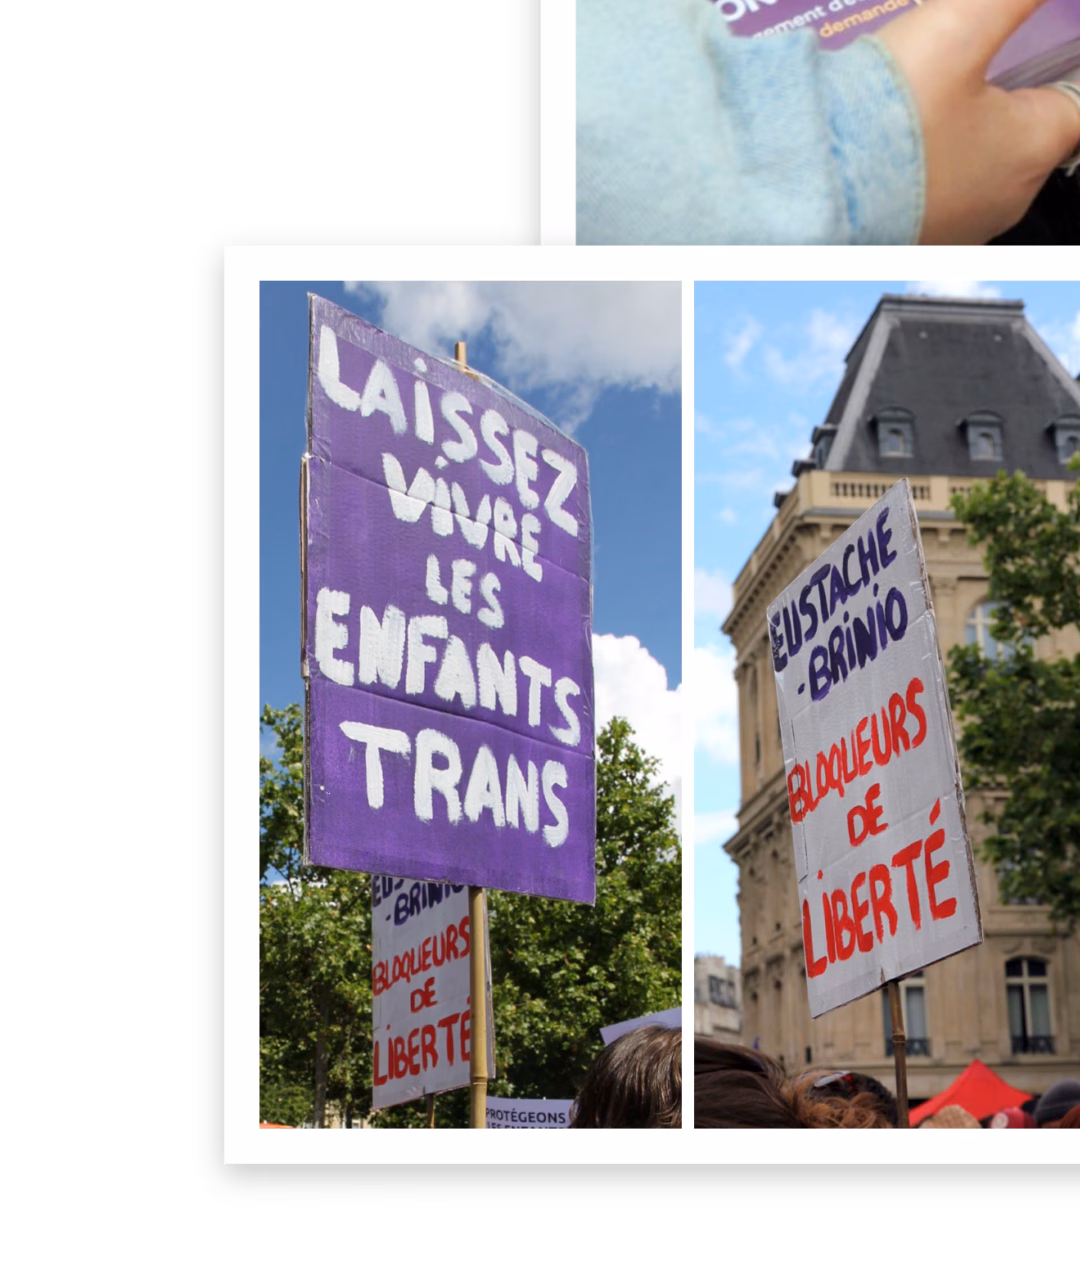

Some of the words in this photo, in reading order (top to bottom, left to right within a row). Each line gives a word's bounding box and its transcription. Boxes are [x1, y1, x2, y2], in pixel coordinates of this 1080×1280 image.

[426, 554, 504, 629] LES
[770, 507, 898, 672] EUSTACHE
[315, 588, 581, 746] ENFANTS
[339, 721, 570, 848] TRANS
[787, 677, 927, 825] BLOQUEURS
[847, 782, 888, 847] DE
[372, 916, 470, 995] BLOQUEURS
[410, 977, 438, 1013] DE
